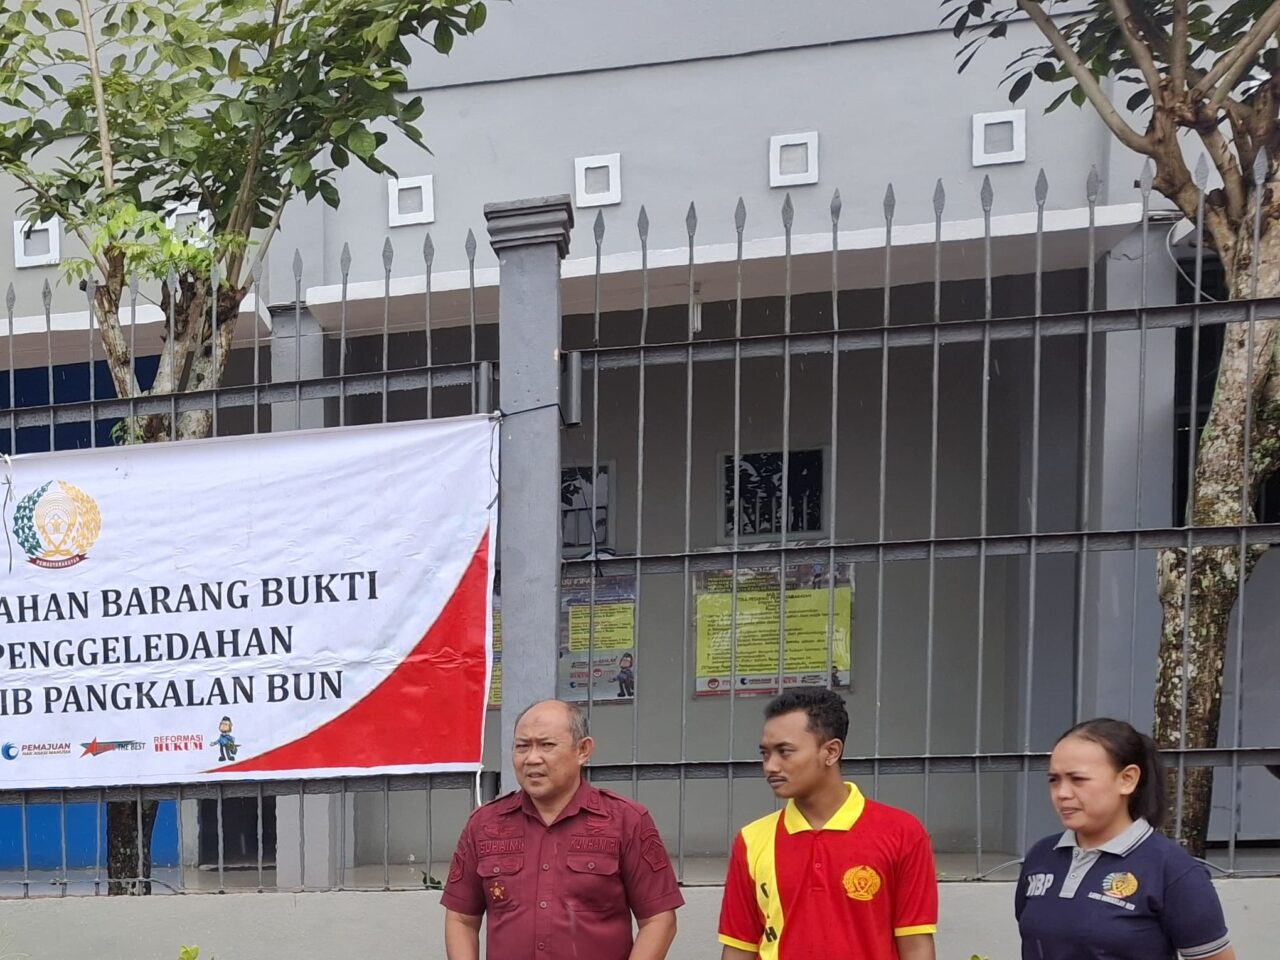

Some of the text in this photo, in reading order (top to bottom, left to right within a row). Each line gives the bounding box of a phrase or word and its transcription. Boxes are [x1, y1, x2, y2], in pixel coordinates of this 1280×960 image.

[101, 580, 249, 618] BARANG
[261, 570, 378, 607] BUKTI
[43, 675, 255, 715] PANGKALAN
[267, 670, 343, 703] BUN
[153, 734, 204, 743] REFORMASI
[22, 742, 71, 751] PEMAJUAN
[130, 742, 146, 751] BEST
[154, 742, 204, 752] HUKUM
